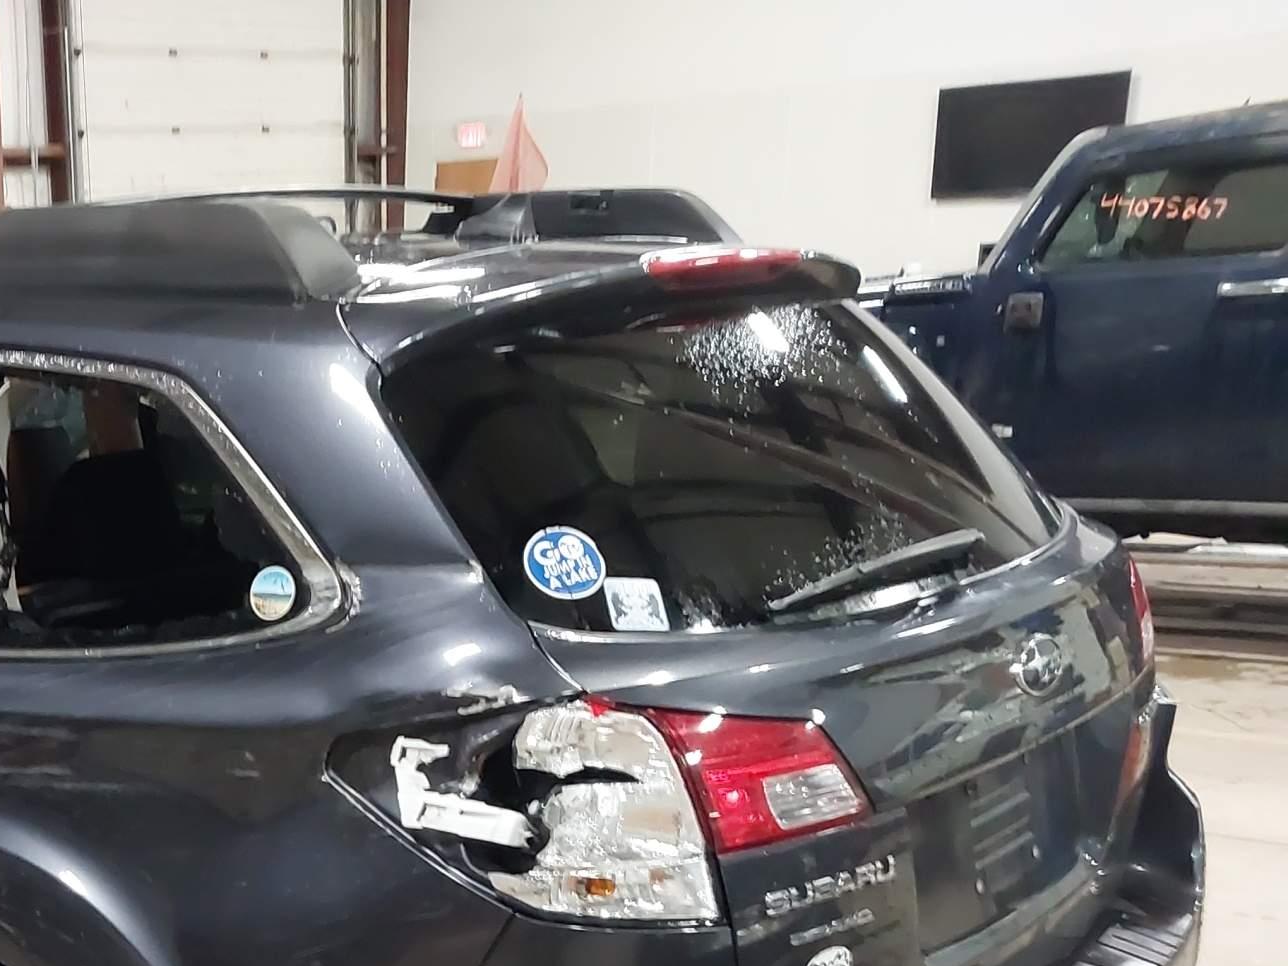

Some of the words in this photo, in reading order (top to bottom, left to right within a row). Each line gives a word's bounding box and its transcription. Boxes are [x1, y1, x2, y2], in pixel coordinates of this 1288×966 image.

[1101, 192, 1228, 221] 44075867
[544, 559, 576, 579] JUMP
[577, 554, 591, 569] IN
[549, 576, 563, 591] A
[562, 565, 598, 587] LAKE
[764, 854, 896, 916] SUBARU
